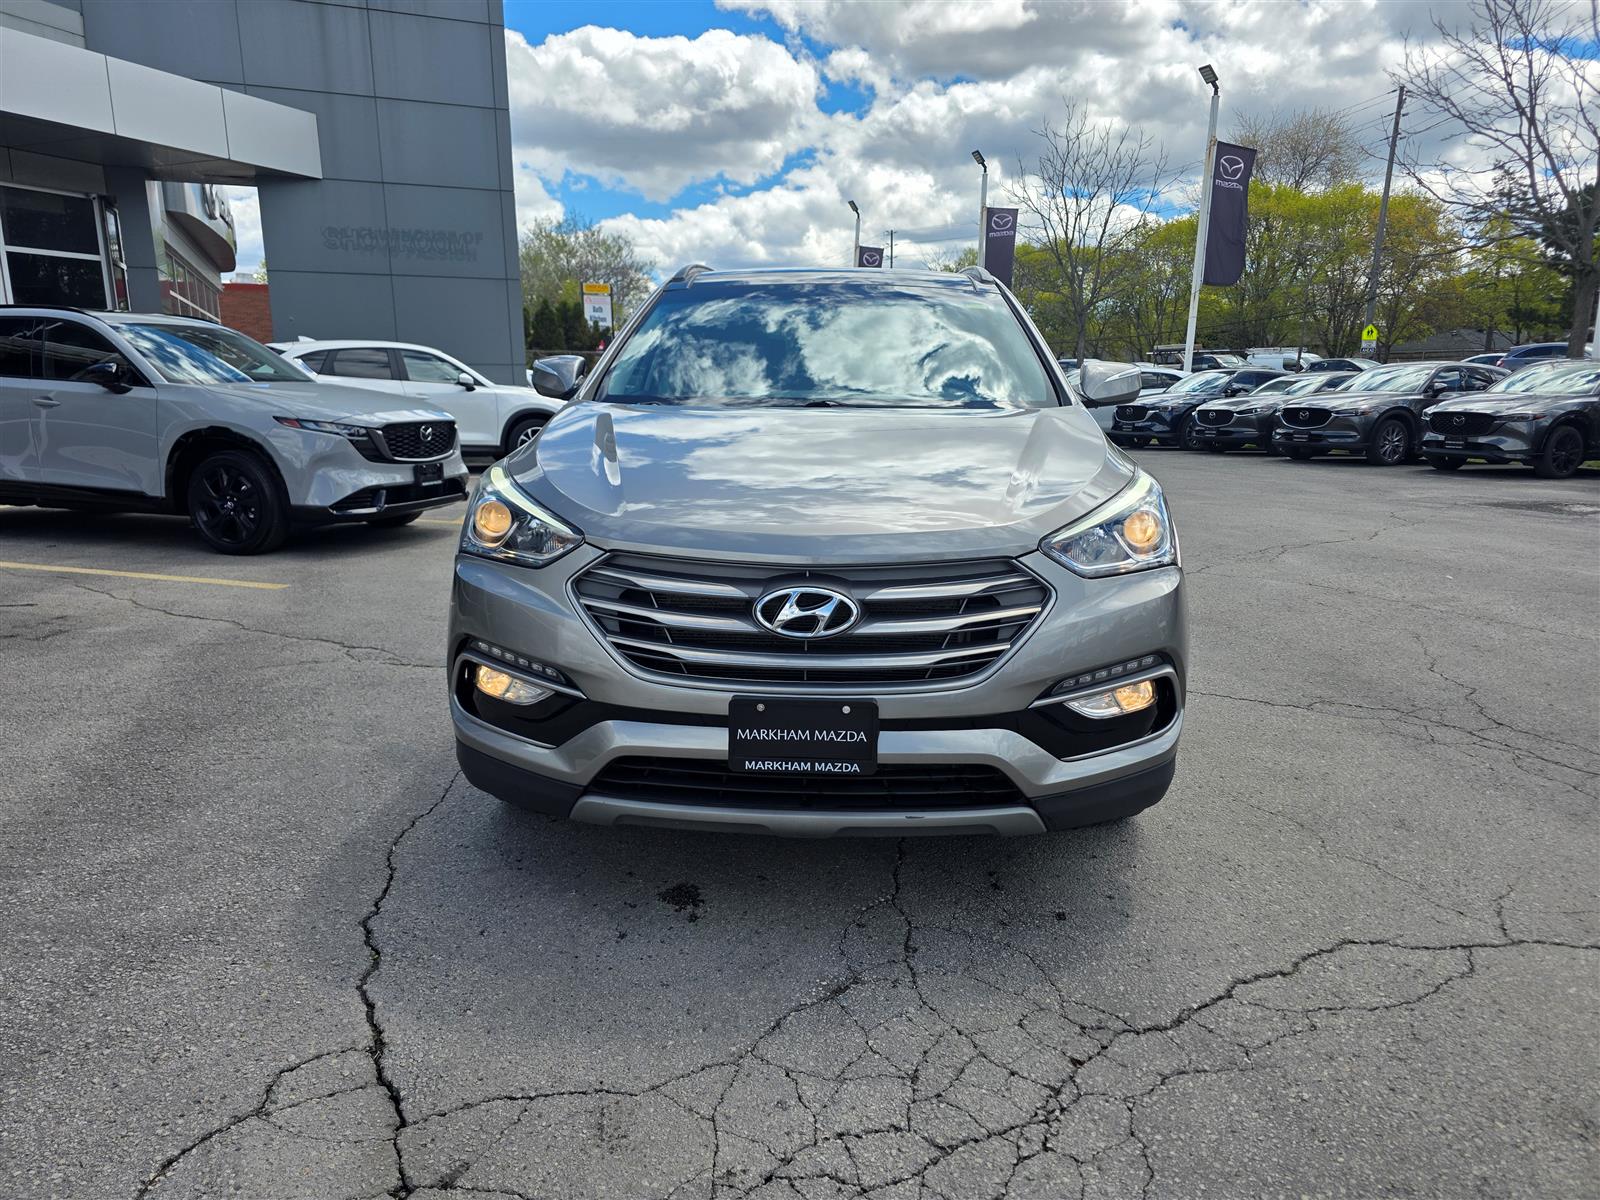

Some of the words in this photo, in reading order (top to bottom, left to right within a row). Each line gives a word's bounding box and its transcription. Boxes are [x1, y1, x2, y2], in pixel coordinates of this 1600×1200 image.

[736, 728, 810, 741] MARKHAM
[814, 729, 867, 742] MAZDA
[745, 760, 811, 771] MARKHAM
[815, 762, 861, 773] MAZDA
